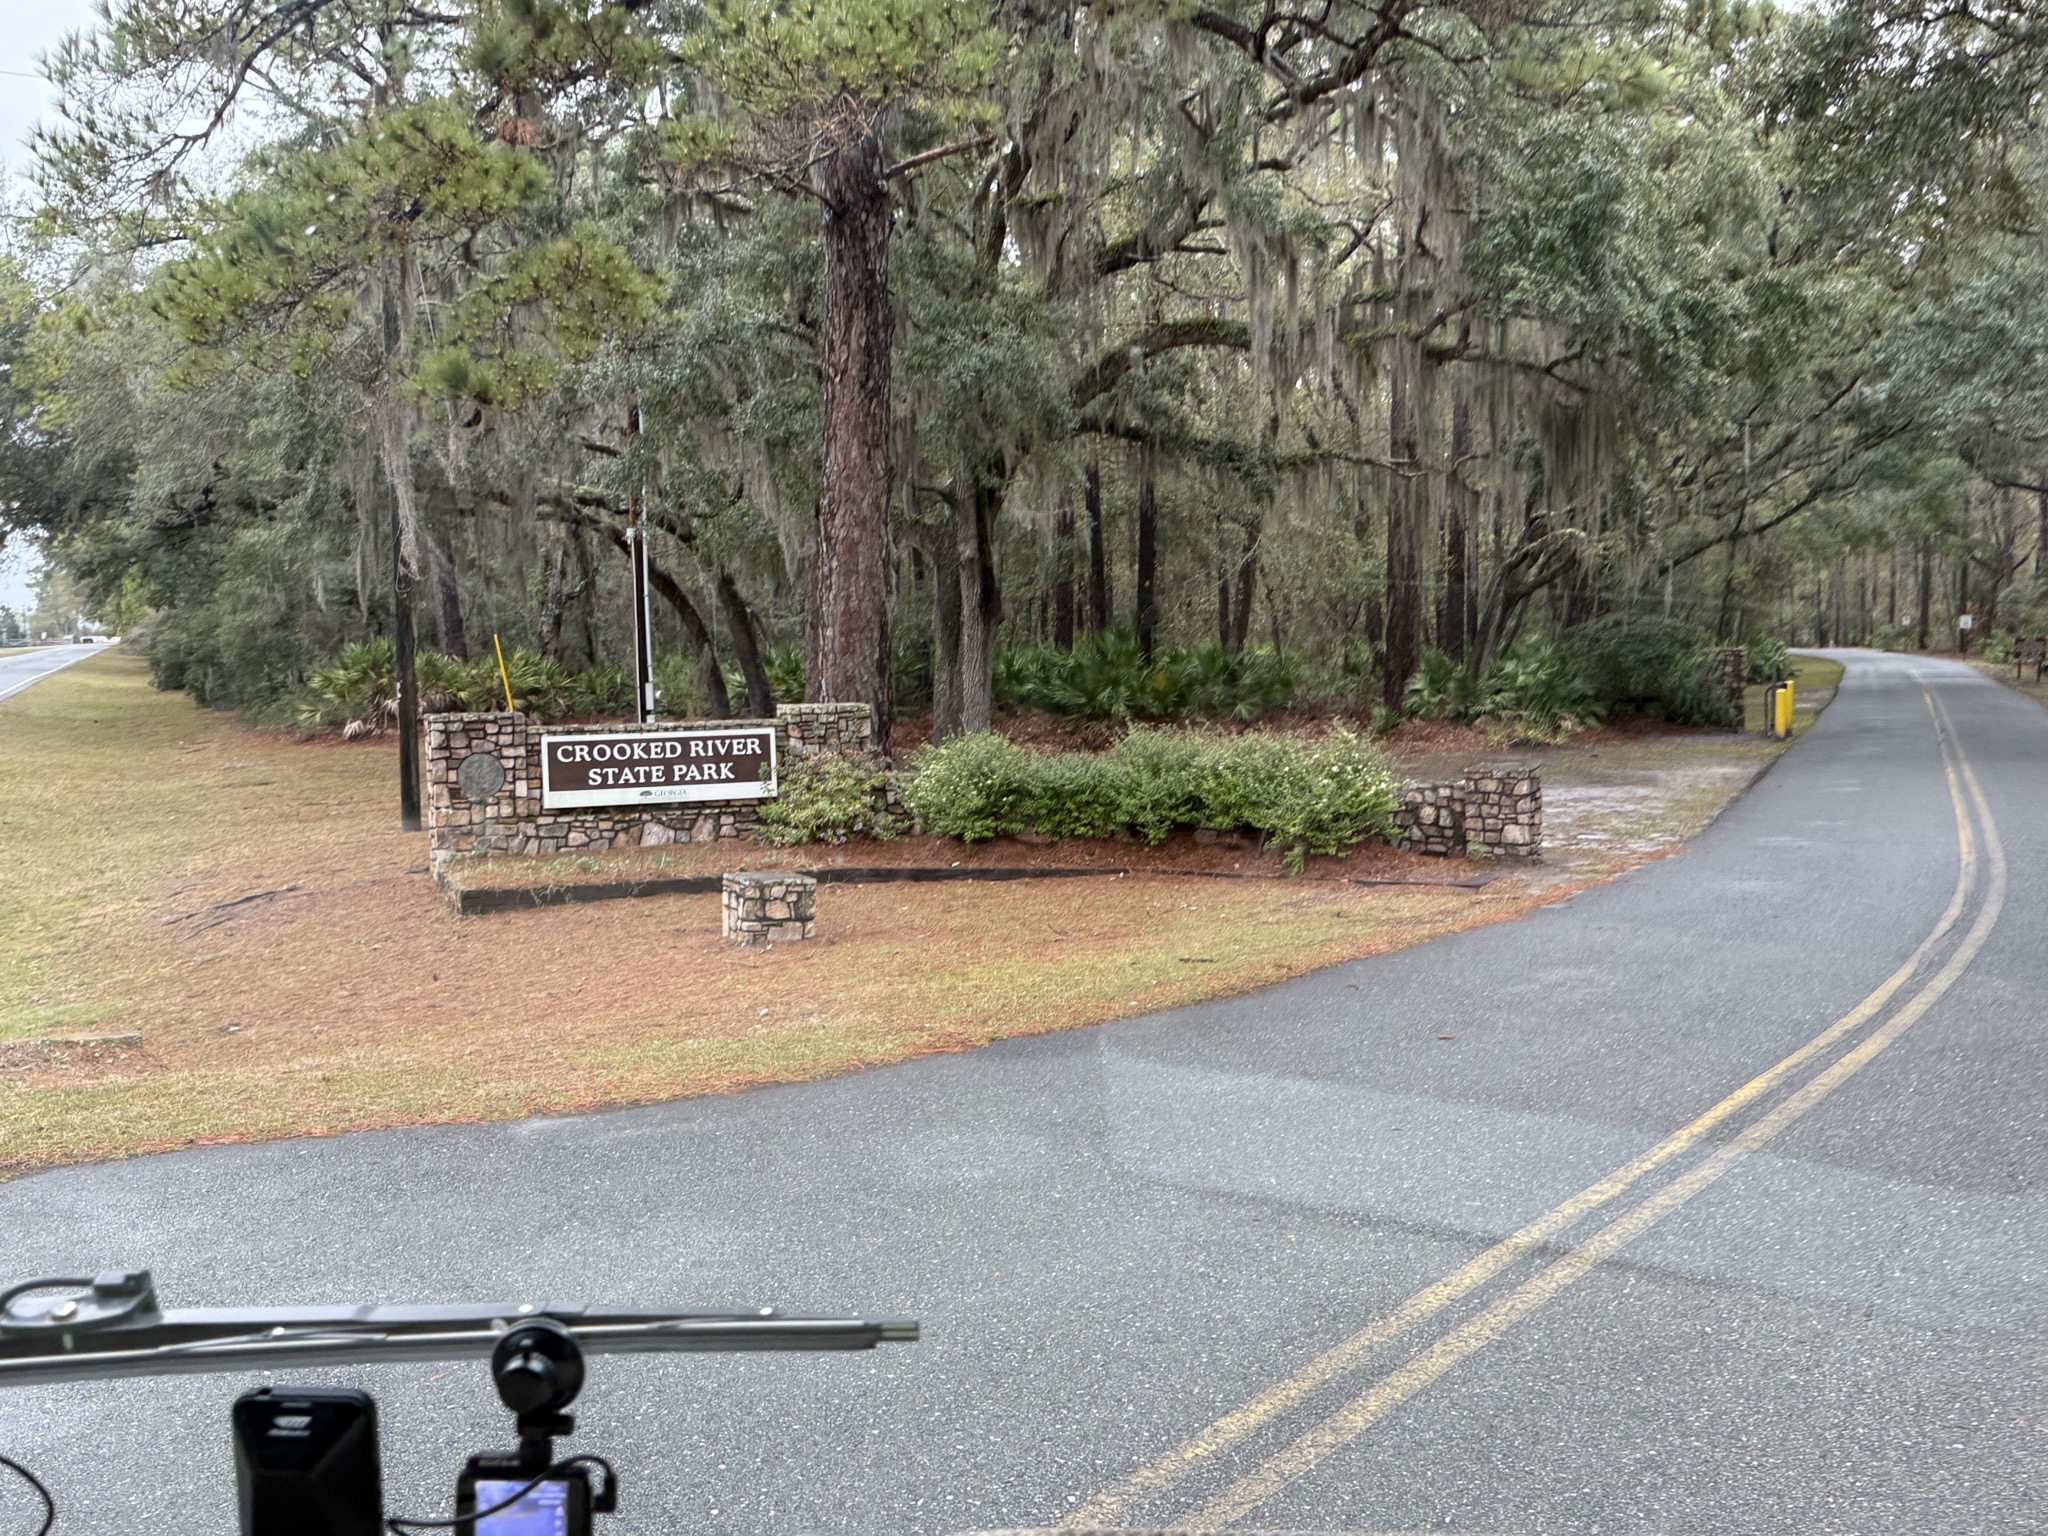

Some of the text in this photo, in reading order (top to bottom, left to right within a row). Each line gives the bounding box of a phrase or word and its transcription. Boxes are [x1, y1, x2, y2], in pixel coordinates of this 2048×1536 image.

[556, 738, 762, 763] CROOKED RIVER
[588, 762, 735, 785] STATE PARK
[654, 788, 688, 797] GEORGIA
